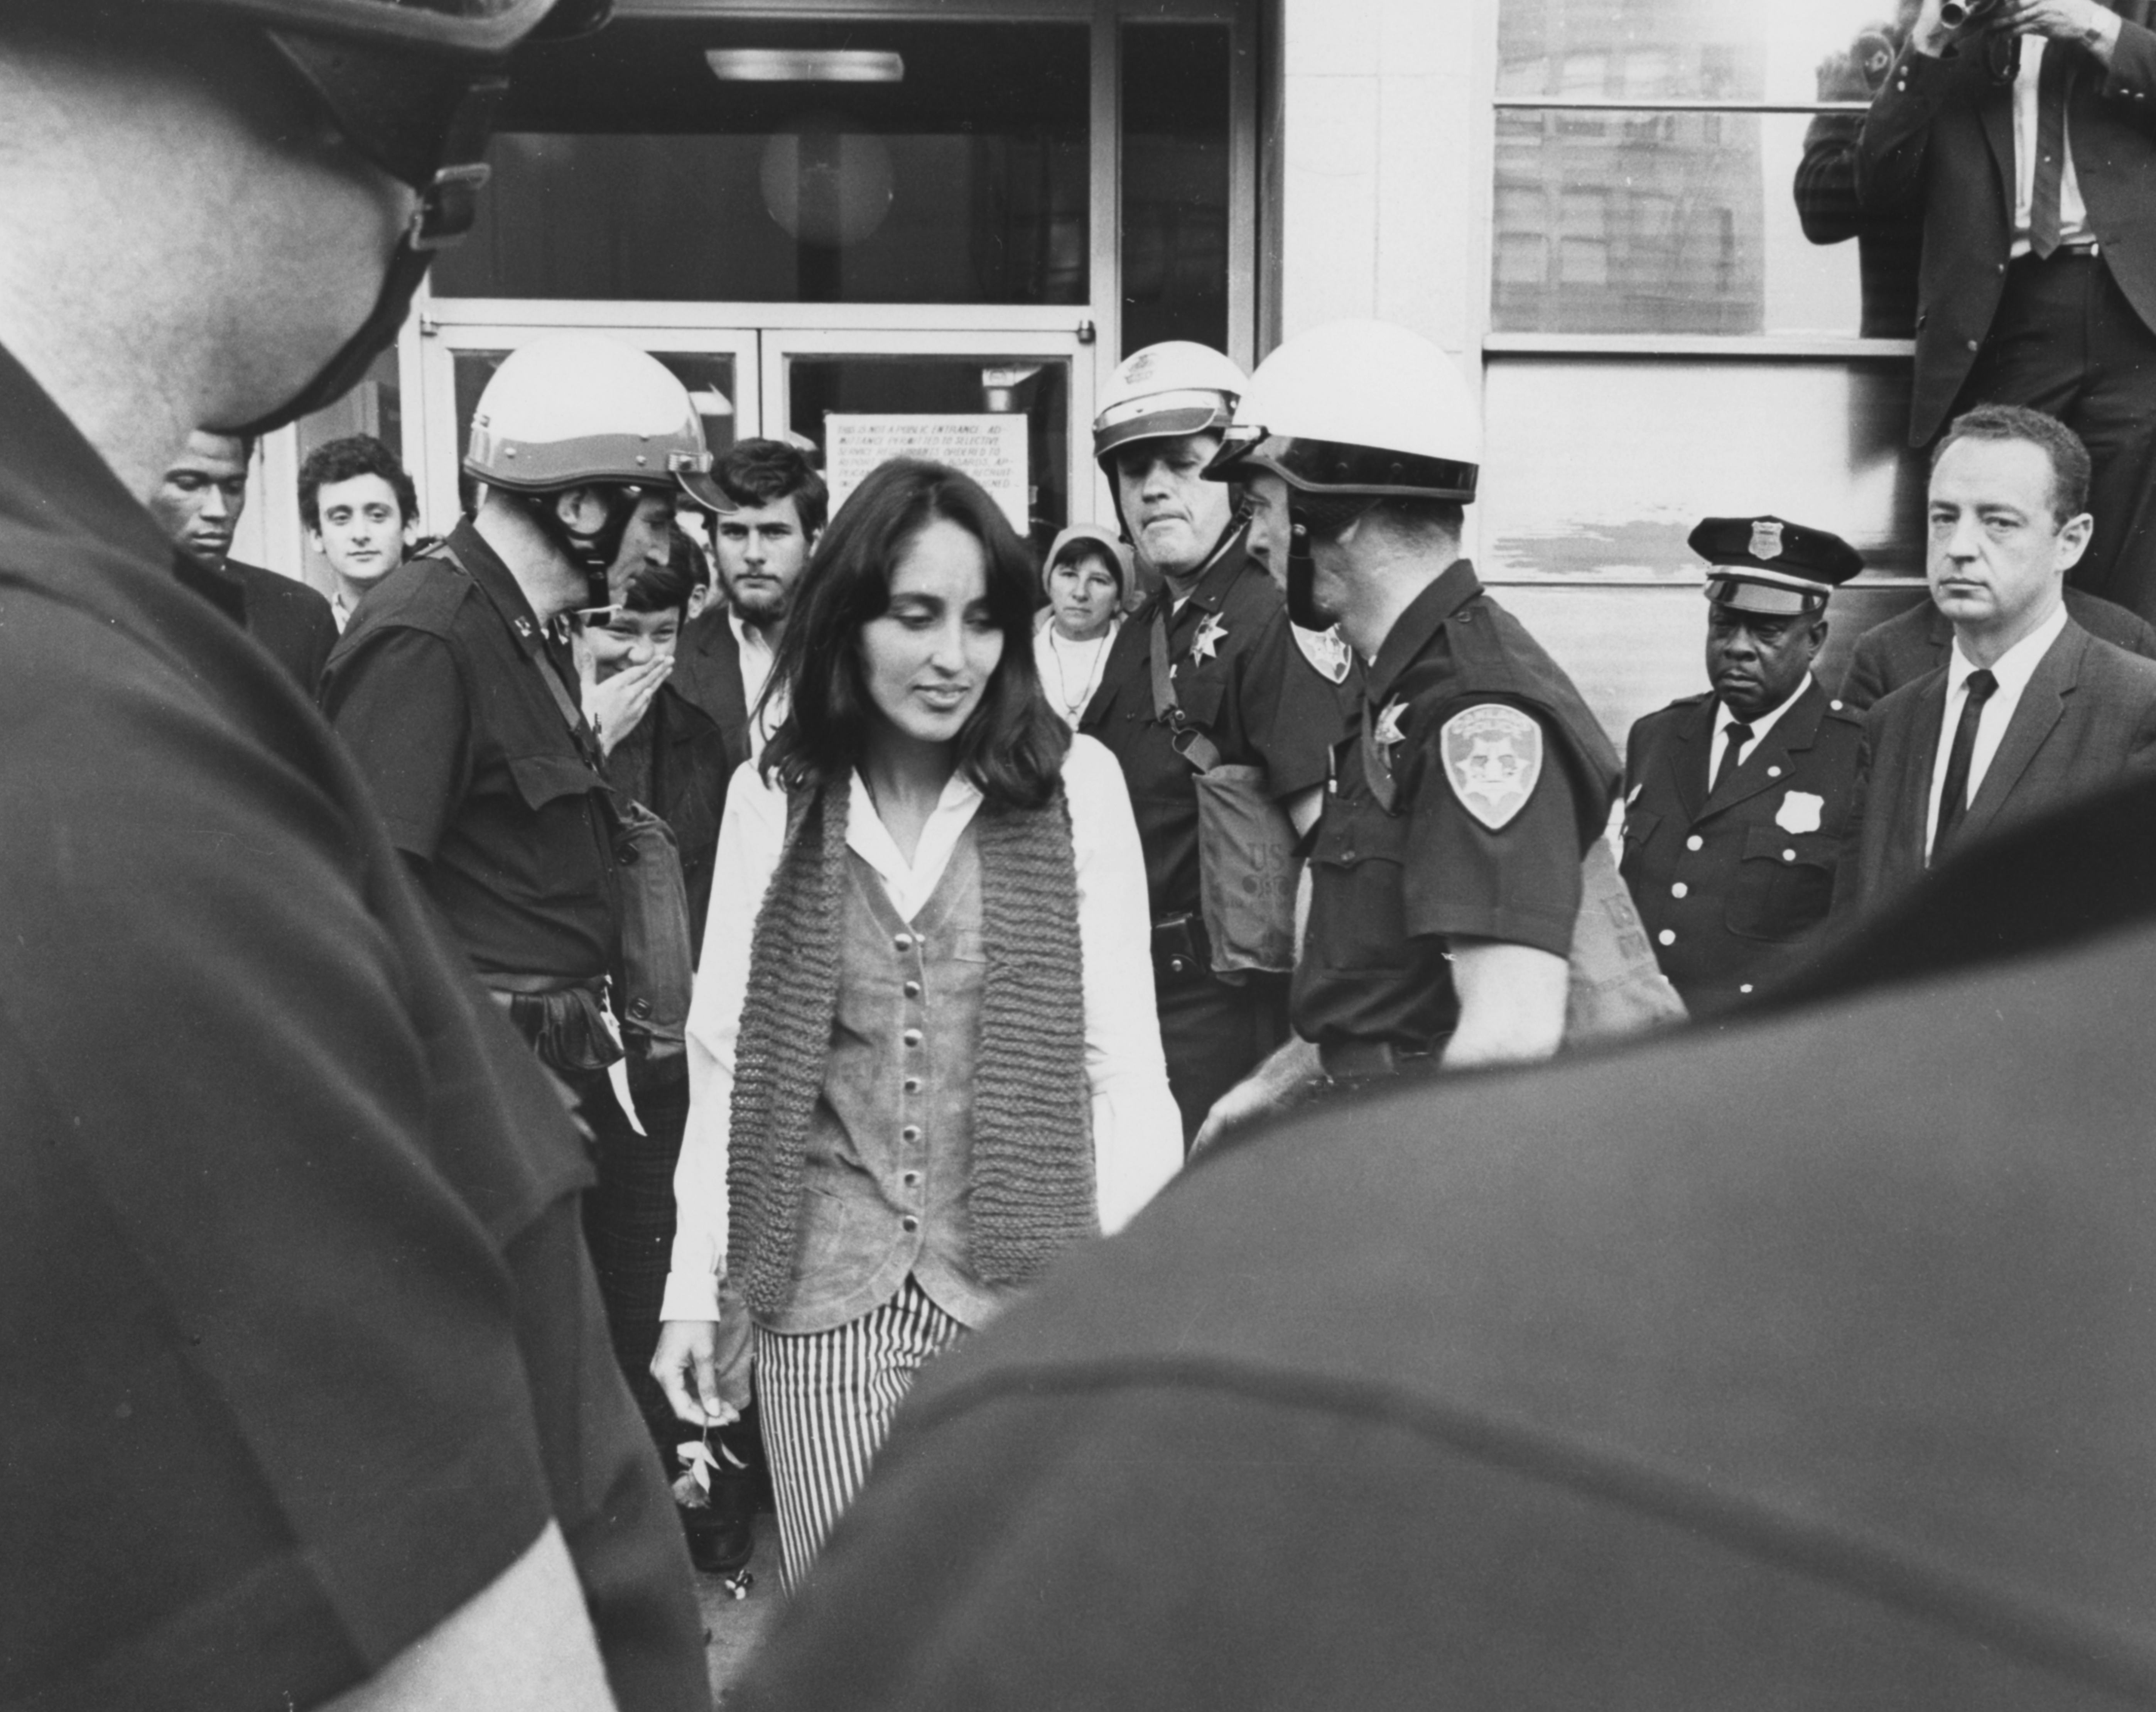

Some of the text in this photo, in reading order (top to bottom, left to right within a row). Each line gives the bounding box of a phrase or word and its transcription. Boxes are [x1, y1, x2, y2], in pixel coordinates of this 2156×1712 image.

[869, 426, 885, 434] NOT
[895, 425, 928, 434] PUBLIC
[888, 436, 940, 445] PERMITTED
[942, 436, 952, 444] TO
[955, 436, 999, 445] SELECTIVE
[943, 448, 986, 456] ORDERED
[989, 448, 1001, 456] TO
